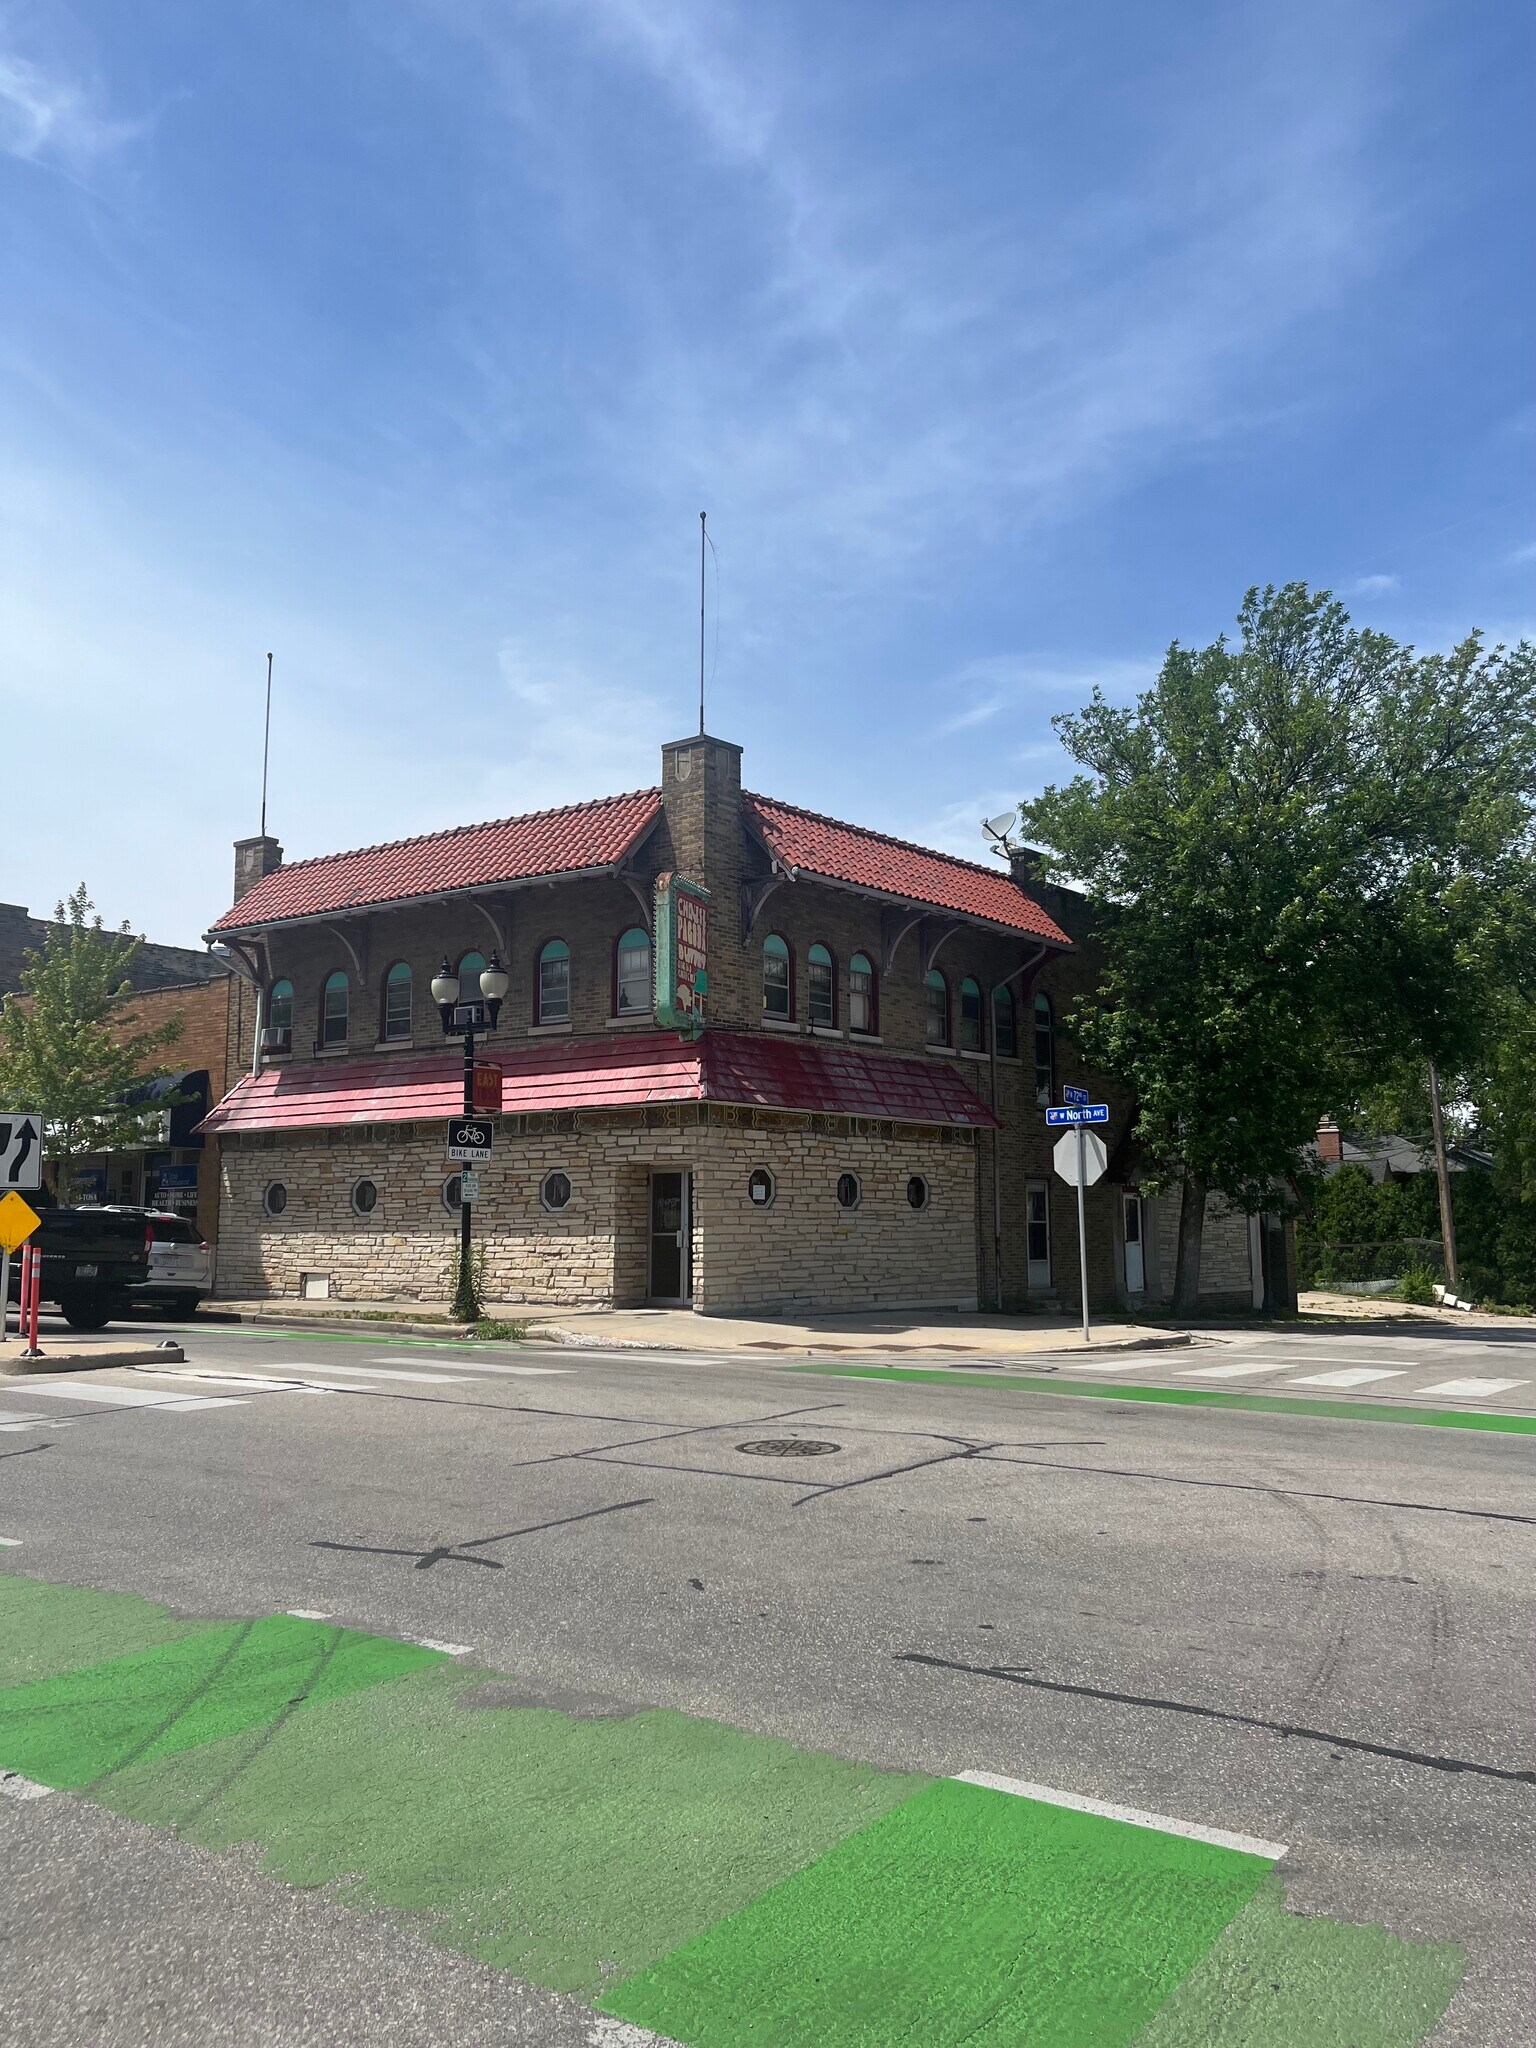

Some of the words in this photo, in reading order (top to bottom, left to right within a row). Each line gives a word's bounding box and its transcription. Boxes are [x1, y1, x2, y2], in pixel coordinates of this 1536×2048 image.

[477, 1073, 498, 1087] EAST
[1066, 1109, 1092, 1121] North
[451, 1148, 467, 1158] BIKE
[471, 1149, 489, 1159] LANE
